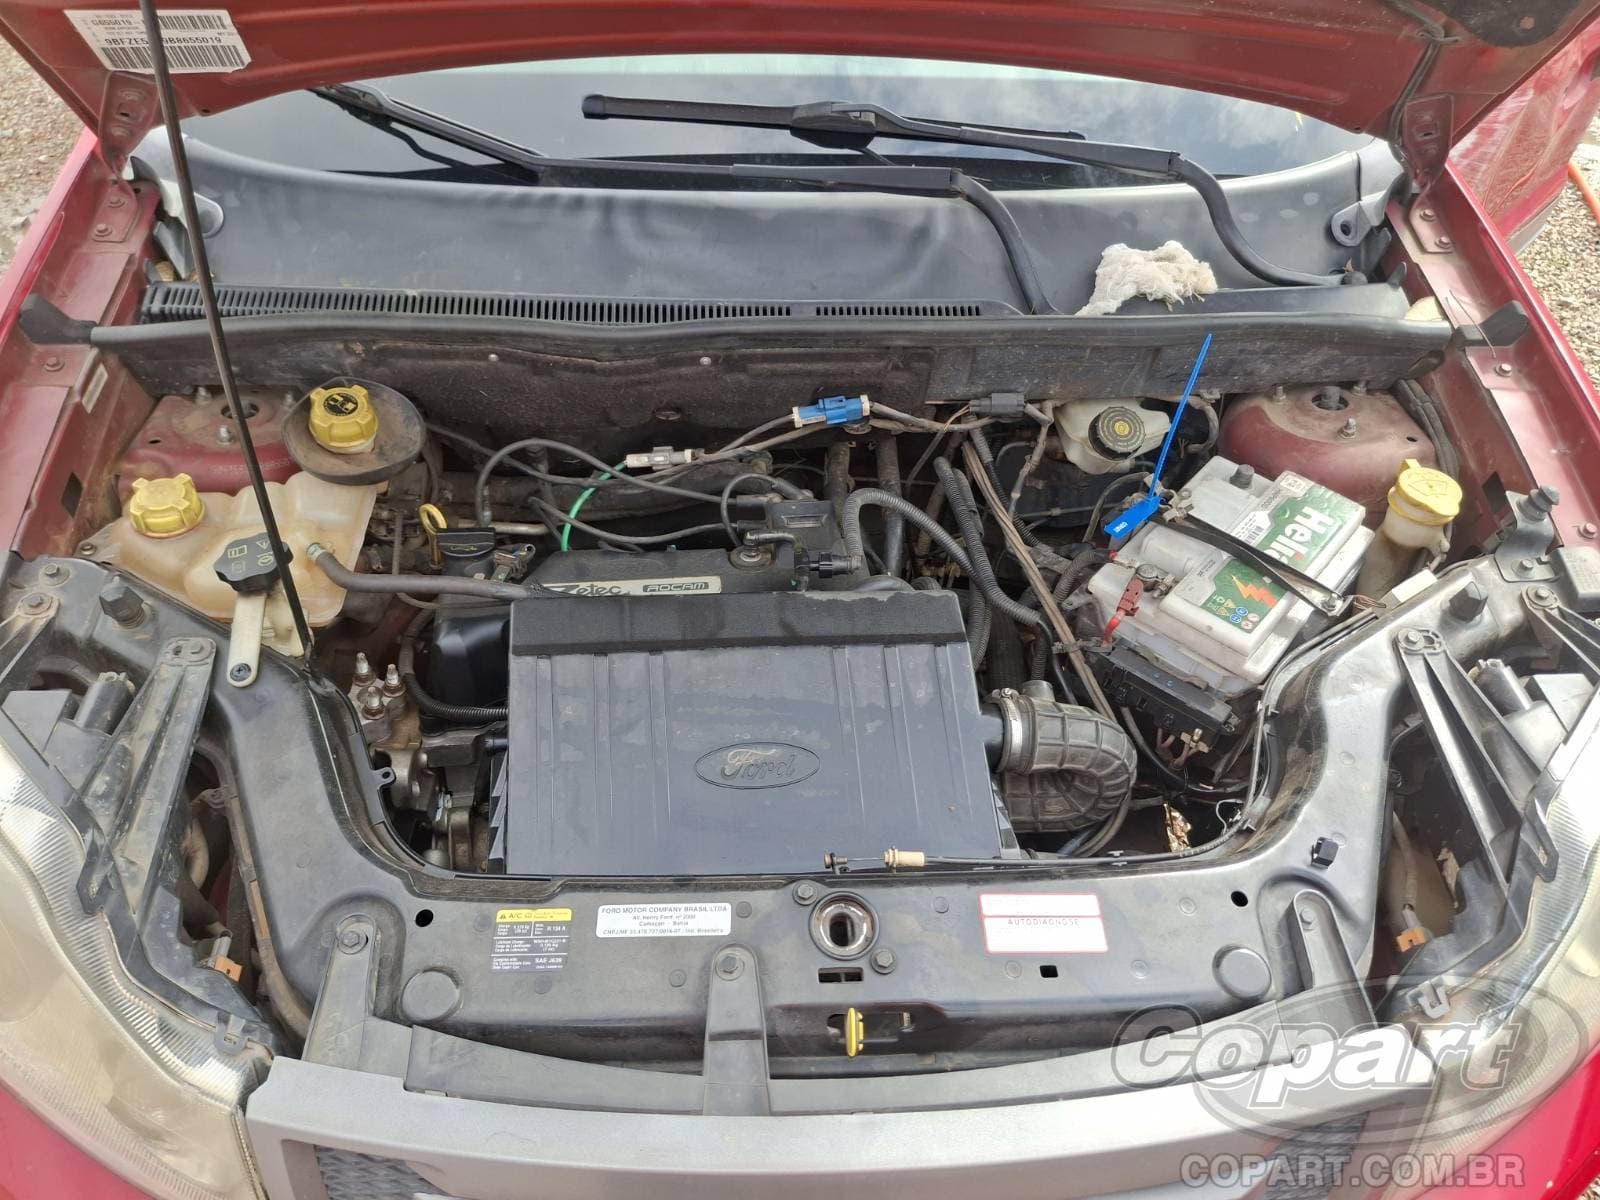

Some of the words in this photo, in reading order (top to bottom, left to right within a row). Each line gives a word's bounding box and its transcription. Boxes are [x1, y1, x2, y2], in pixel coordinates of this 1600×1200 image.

[646, 582, 706, 592] ROCAM
[721, 748, 797, 781] Ford
[622, 906, 647, 914] MOTOR
[683, 905, 708, 913] BRASIL
[1007, 918, 1080, 926] AUTODIAGNOSE
